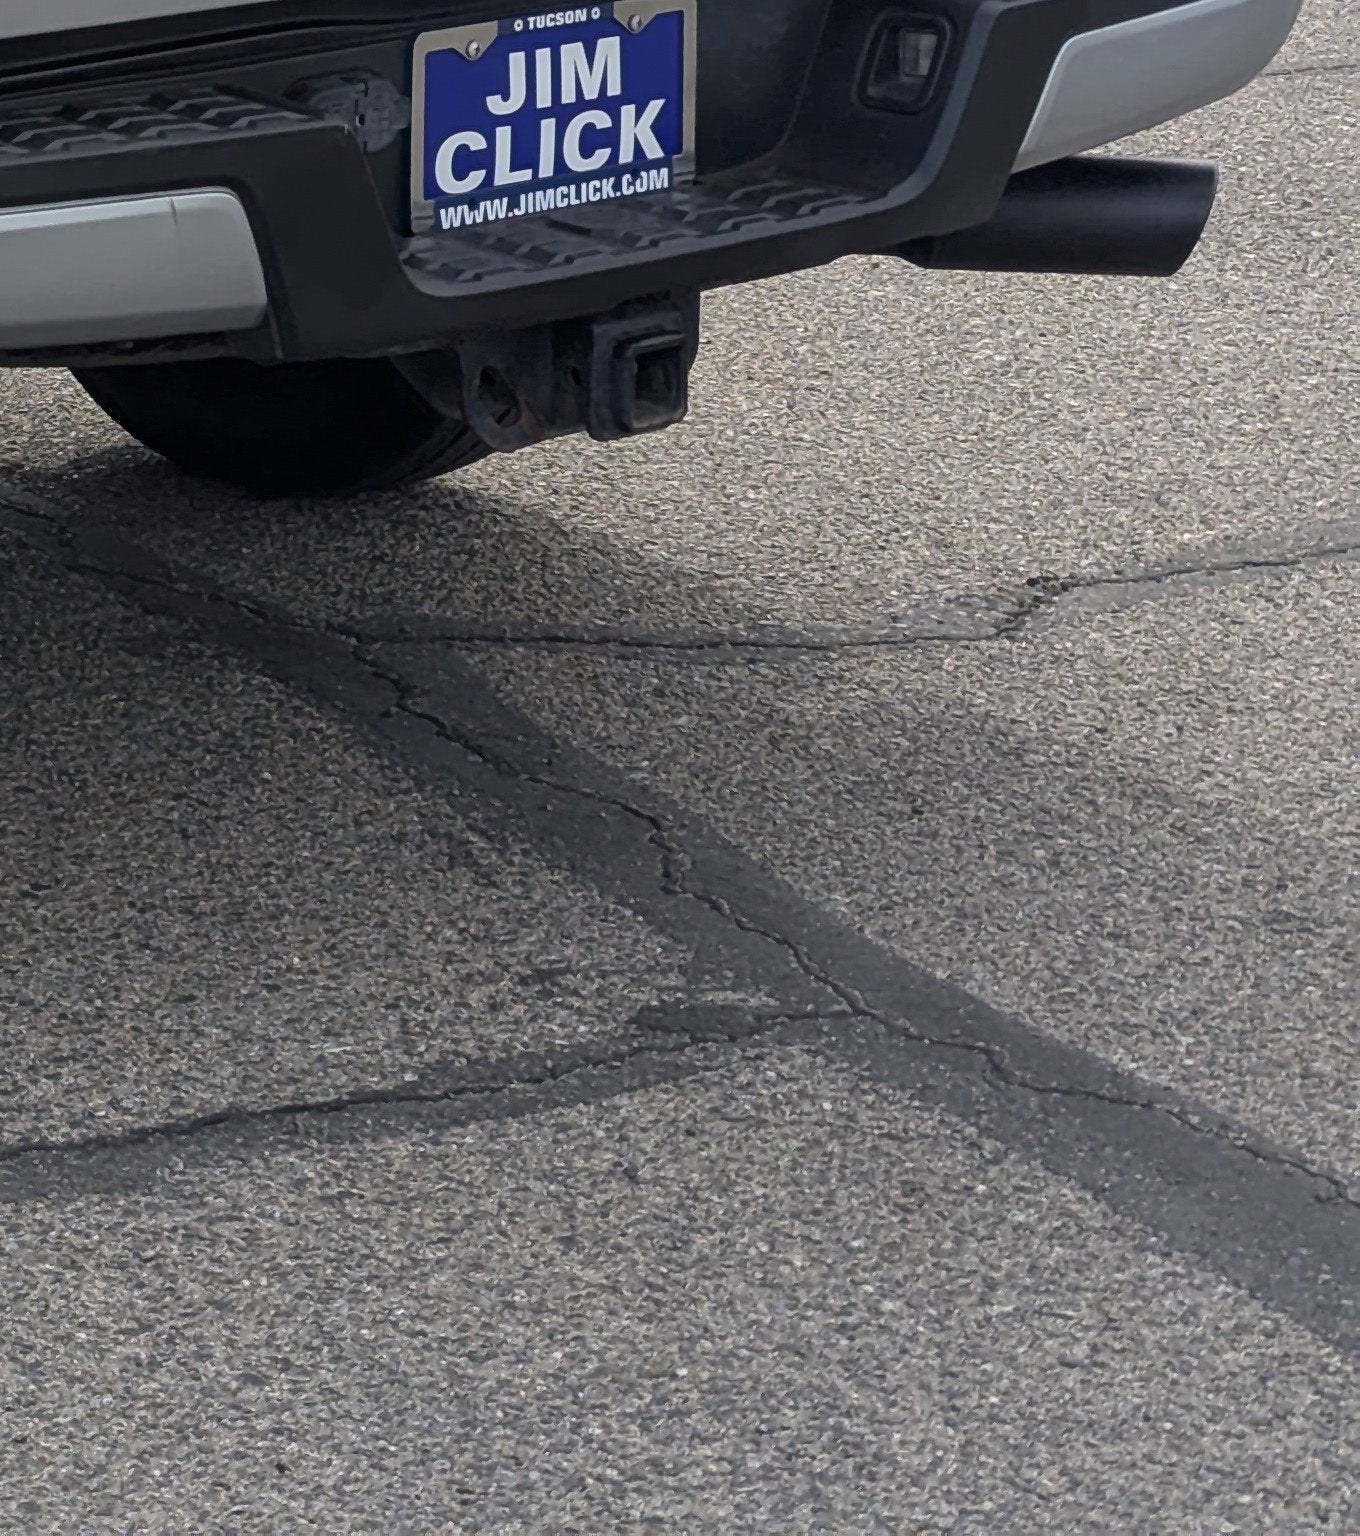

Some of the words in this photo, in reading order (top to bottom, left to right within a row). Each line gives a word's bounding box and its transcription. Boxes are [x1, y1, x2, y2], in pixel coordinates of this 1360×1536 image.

[528, 8, 587, 30] TUCSON
[486, 36, 621, 115] JIM
[434, 99, 666, 195] CLICK
[439, 167, 669, 230] WWW.JIMCLICK.COM
